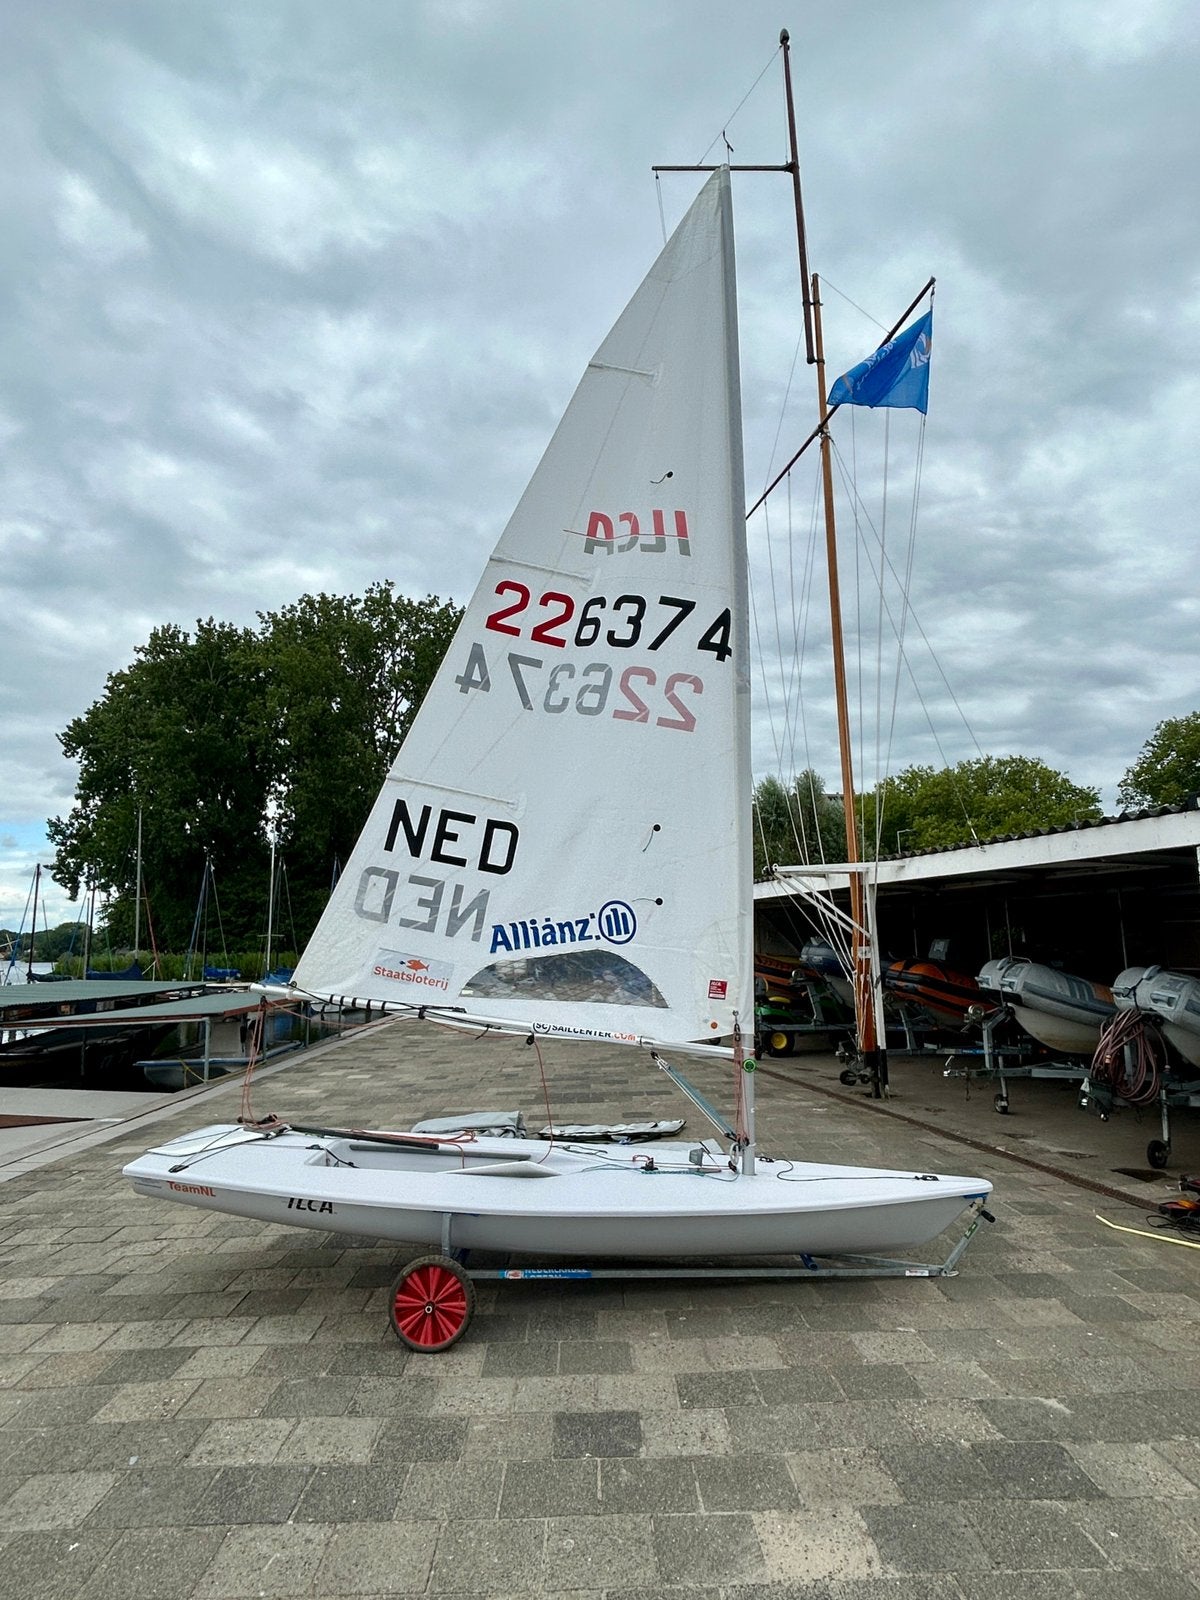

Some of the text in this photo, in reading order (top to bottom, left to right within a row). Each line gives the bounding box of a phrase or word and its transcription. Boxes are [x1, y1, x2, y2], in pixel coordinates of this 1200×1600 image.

[485, 580, 733, 662] 226374
[384, 799, 519, 875] NED
[490, 913, 596, 953] Allianz
[373, 965, 449, 991] Staatsloterij
[167, 1180, 217, 1197] TeamNL
